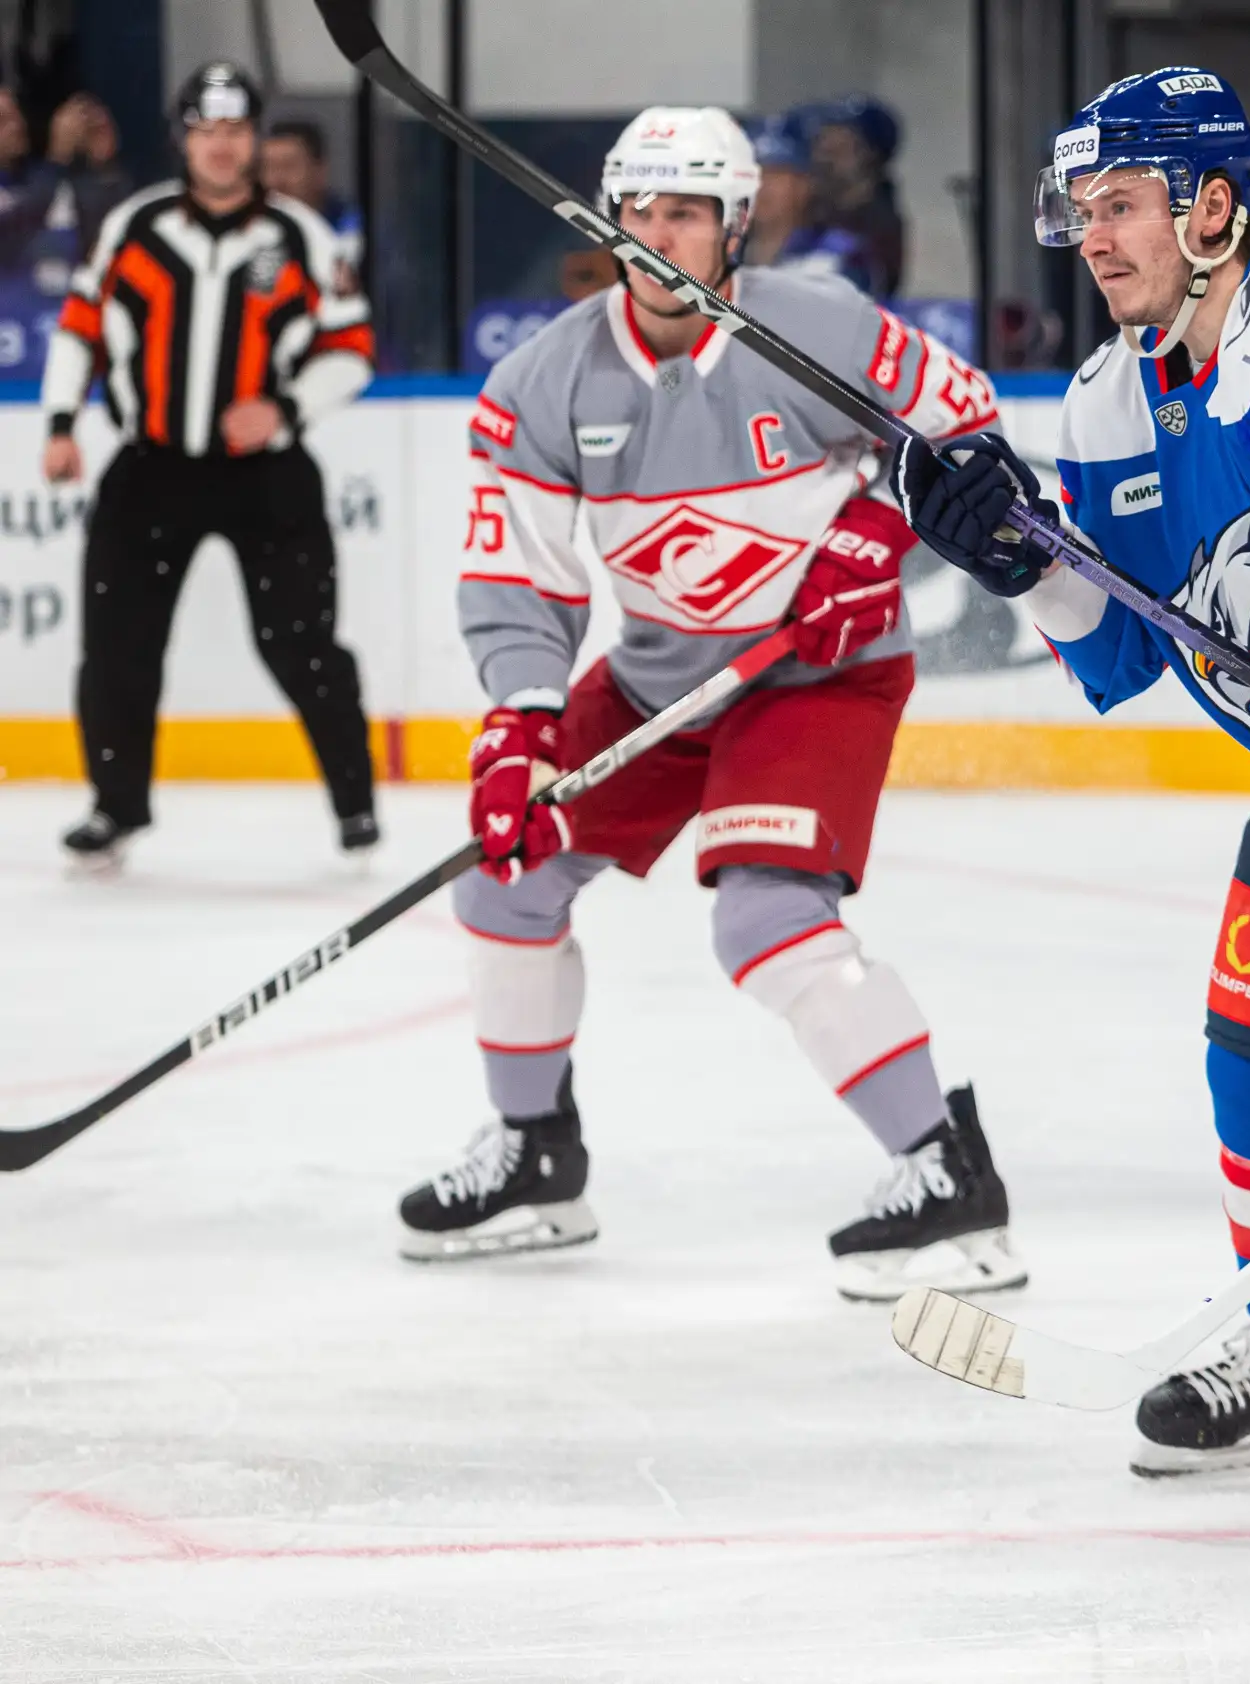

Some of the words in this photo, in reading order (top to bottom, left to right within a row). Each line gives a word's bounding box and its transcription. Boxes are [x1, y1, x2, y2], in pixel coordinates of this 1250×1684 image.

[1166, 78, 1217, 93] LADA
[1199, 122, 1245, 133] BAUER
[1055, 138, 1095, 161] согаз
